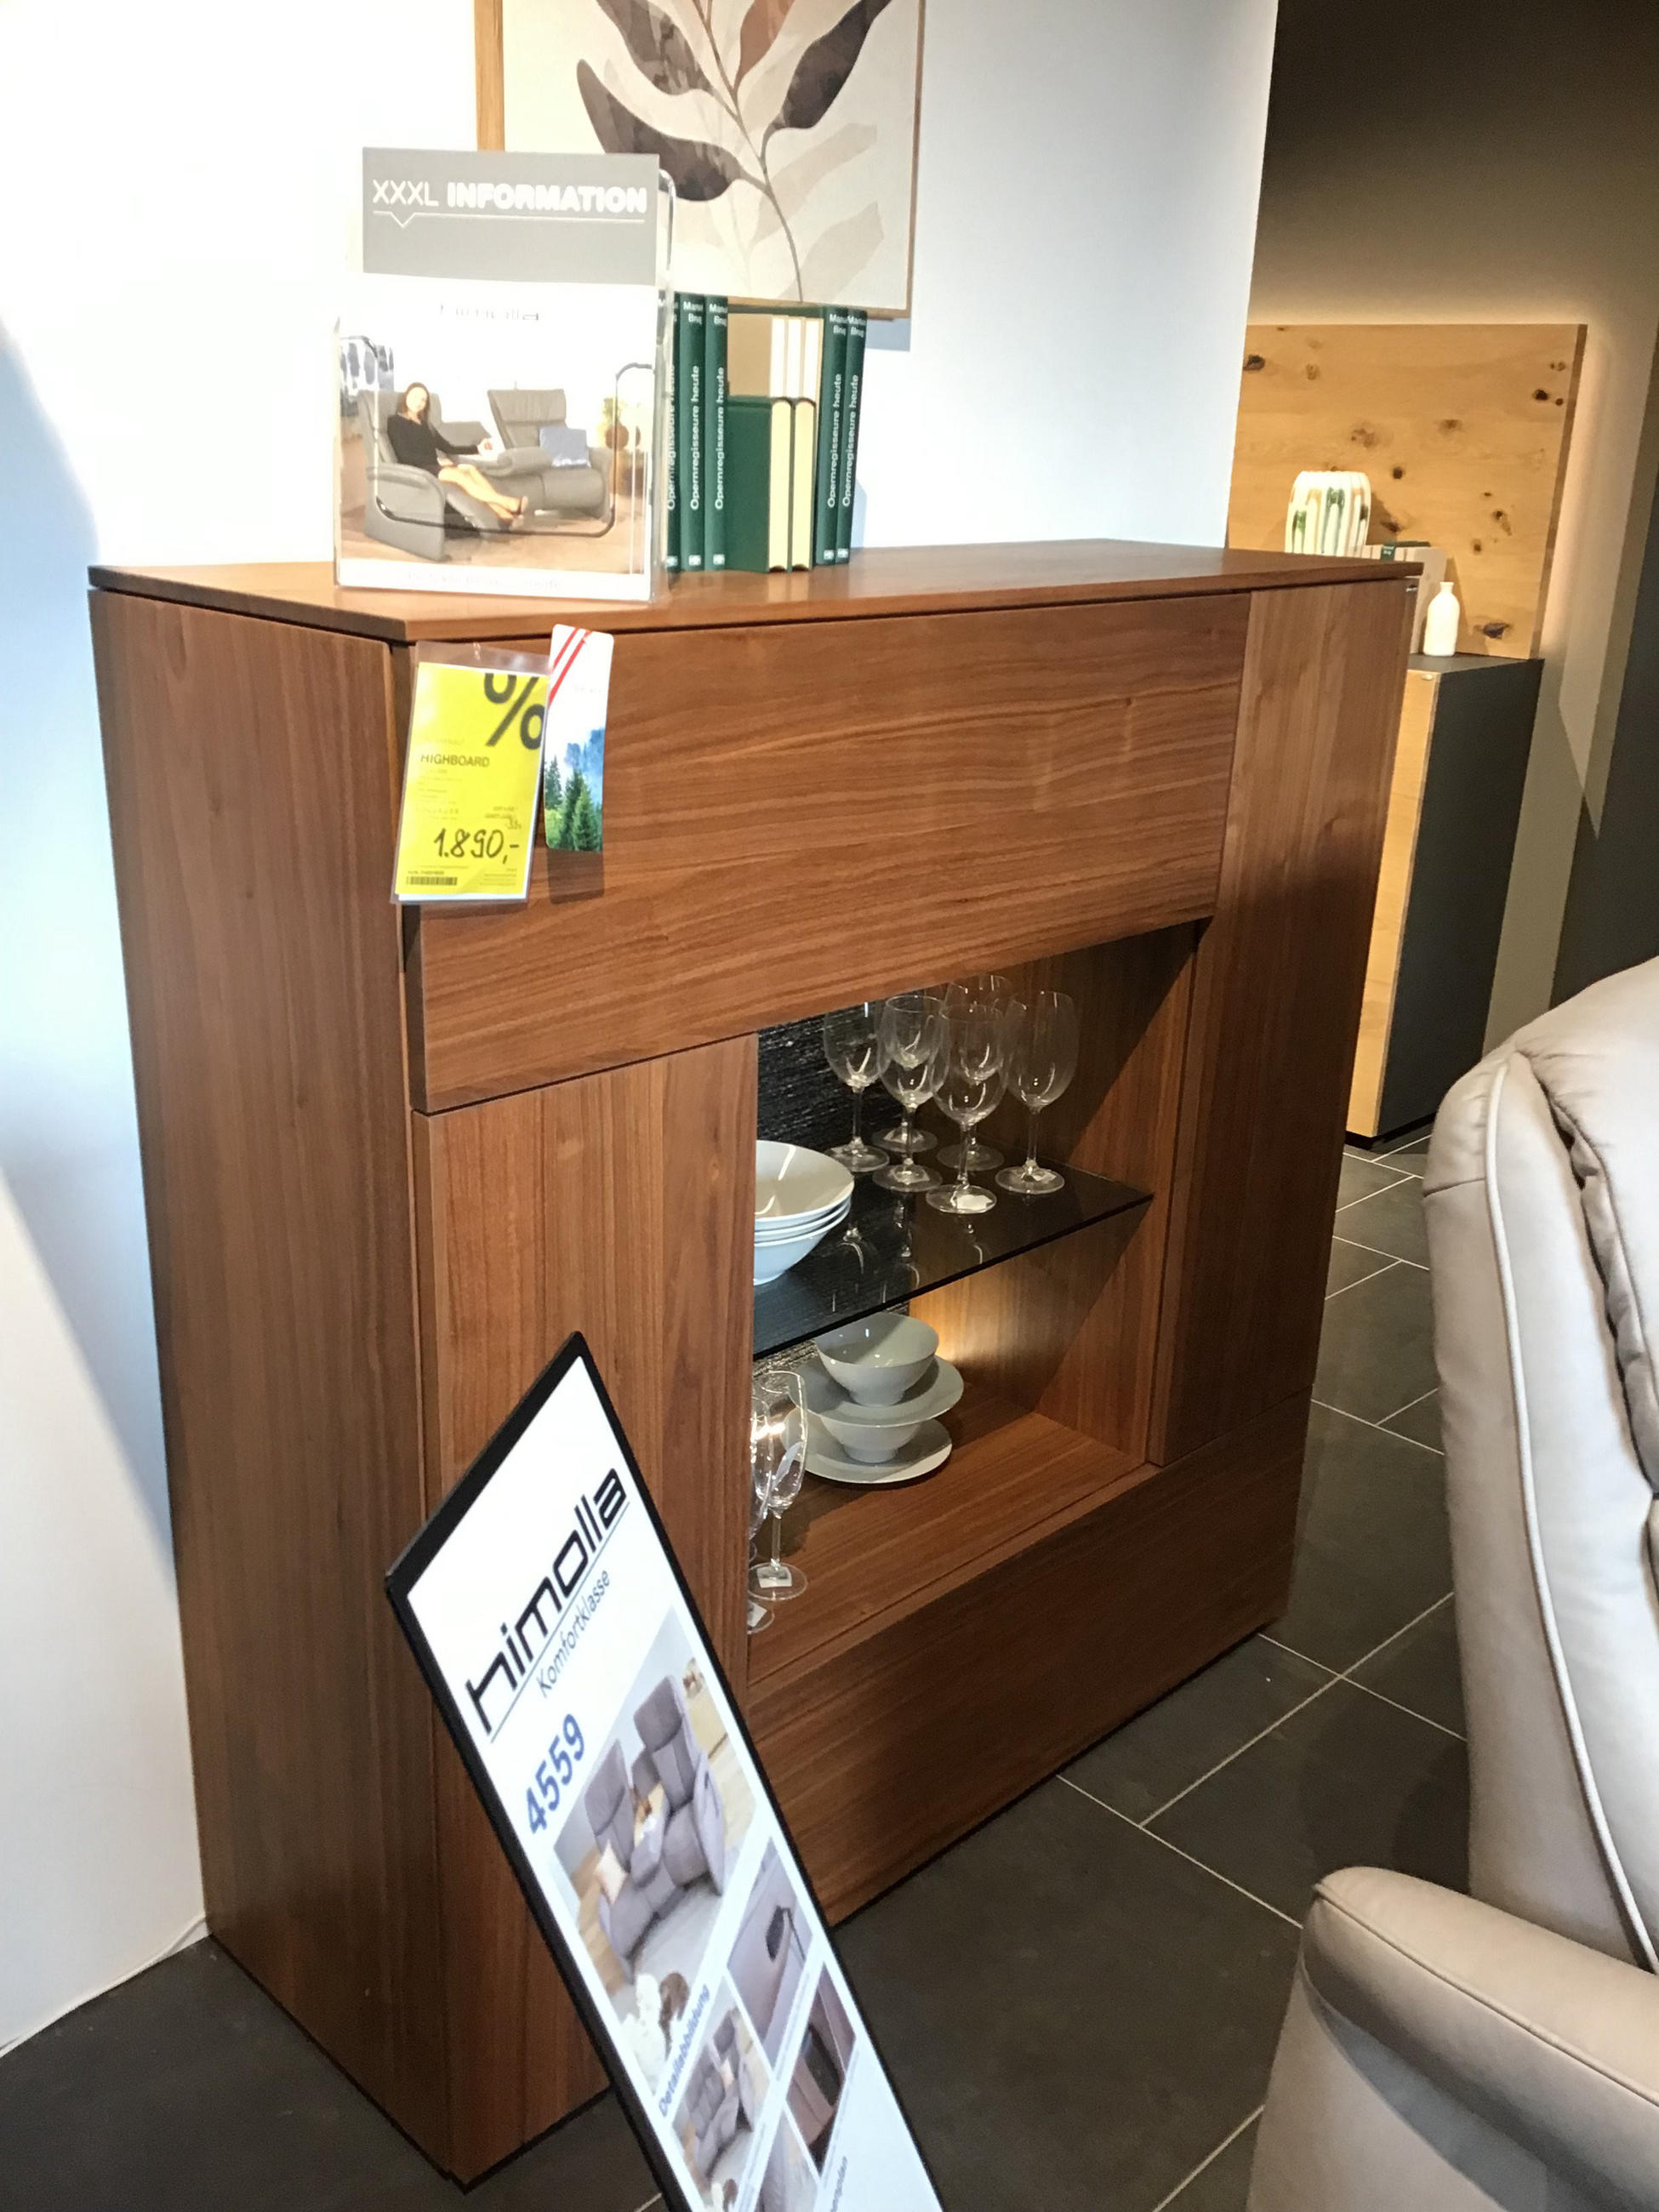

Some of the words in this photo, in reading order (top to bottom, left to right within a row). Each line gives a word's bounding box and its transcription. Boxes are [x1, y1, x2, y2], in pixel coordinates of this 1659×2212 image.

[372, 179, 439, 207] XXXL
[447, 181, 647, 214] INFORMATION
[690, 365, 700, 402] heute
[715, 367, 725, 404] heute
[832, 373, 842, 408] heute
[849, 374, 859, 408] heute
[690, 406, 700, 510] Opernregisseure
[715, 407, 725, 510] Opernregisseure
[827, 410, 841, 509] Opernregisseure
[842, 411, 857, 508] Opernregisseure
[483, 672, 546, 750] %
[420, 753, 490, 767] HIGHBOARD
[465, 1468, 628, 1735] himolla
[536, 1570, 611, 1698] Komfortklasse
[526, 1713, 585, 1835] 4559
